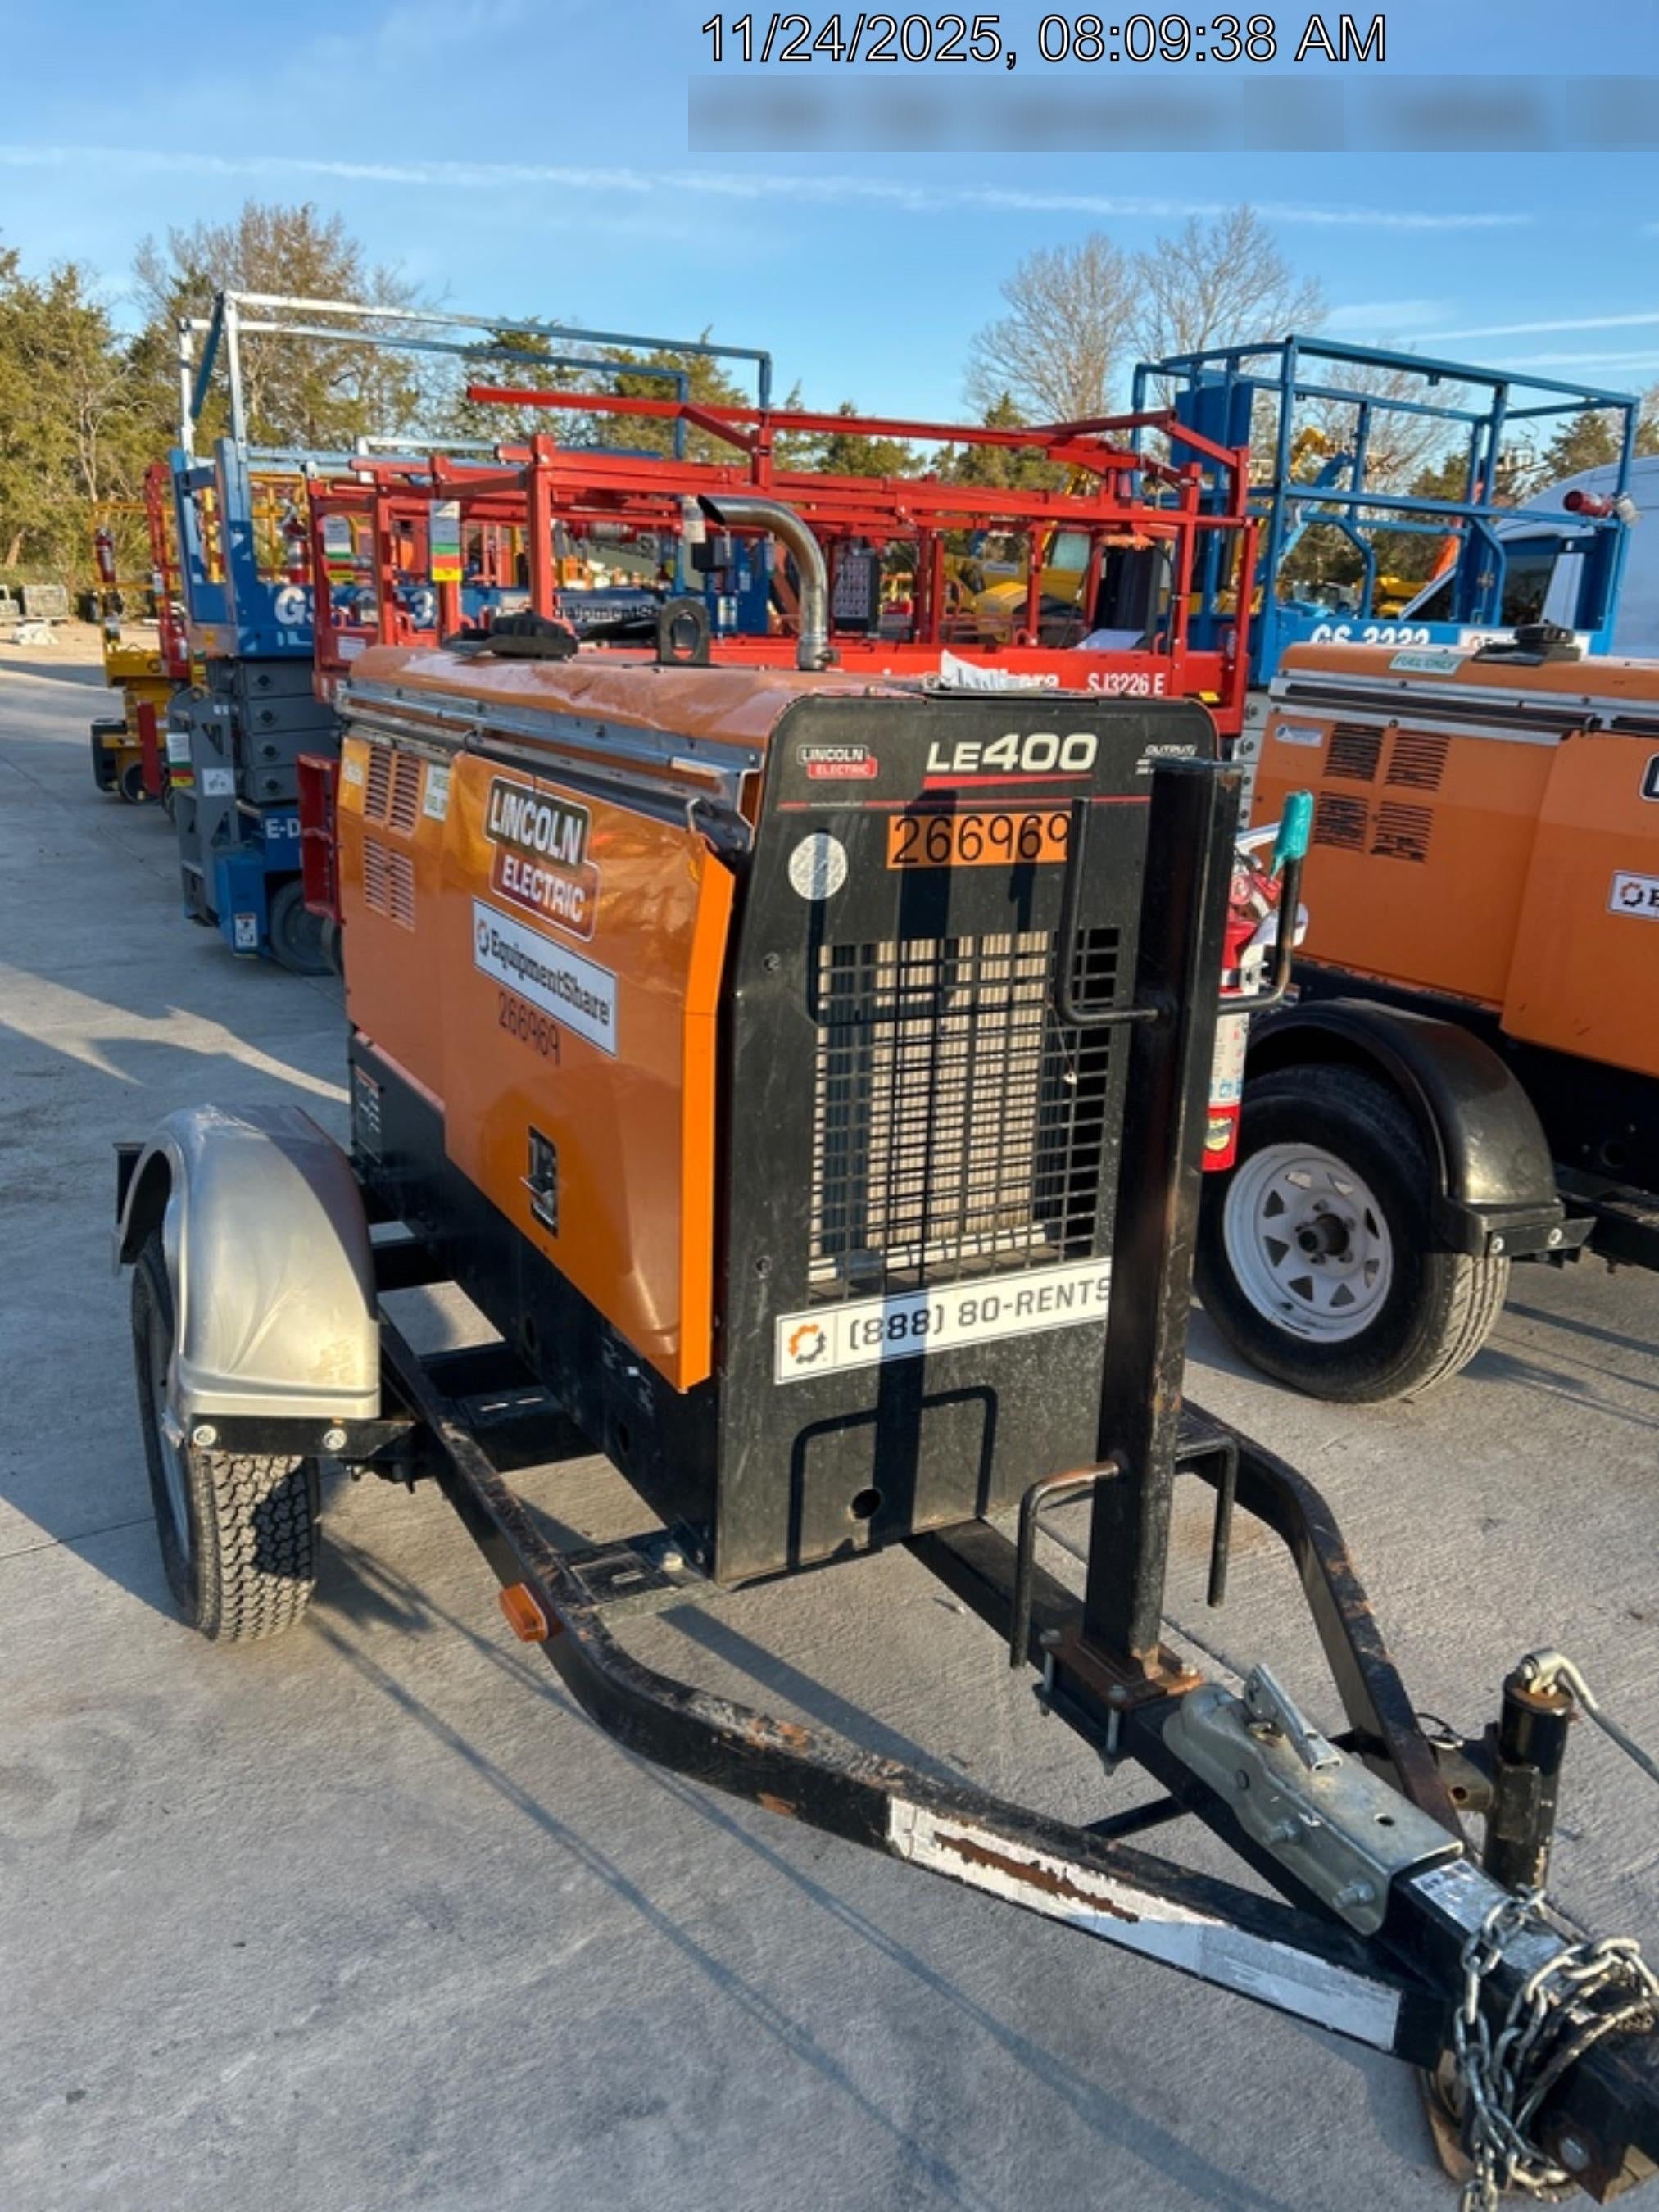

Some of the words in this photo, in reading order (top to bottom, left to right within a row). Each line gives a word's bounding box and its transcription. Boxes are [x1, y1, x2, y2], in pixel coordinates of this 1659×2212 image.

[801, 748, 864, 762] LINCOLN
[815, 763, 870, 775] ELECTRIC
[926, 733, 1098, 771] LE400
[490, 788, 582, 866] LINCOLN
[502, 854, 586, 923] ELECTRIC
[491, 928, 610, 1026] EquipmentShare
[498, 990, 561, 1066] 266969
[850, 1304, 945, 1350] (888)
[958, 1277, 1110, 1328] 80-RENTS
